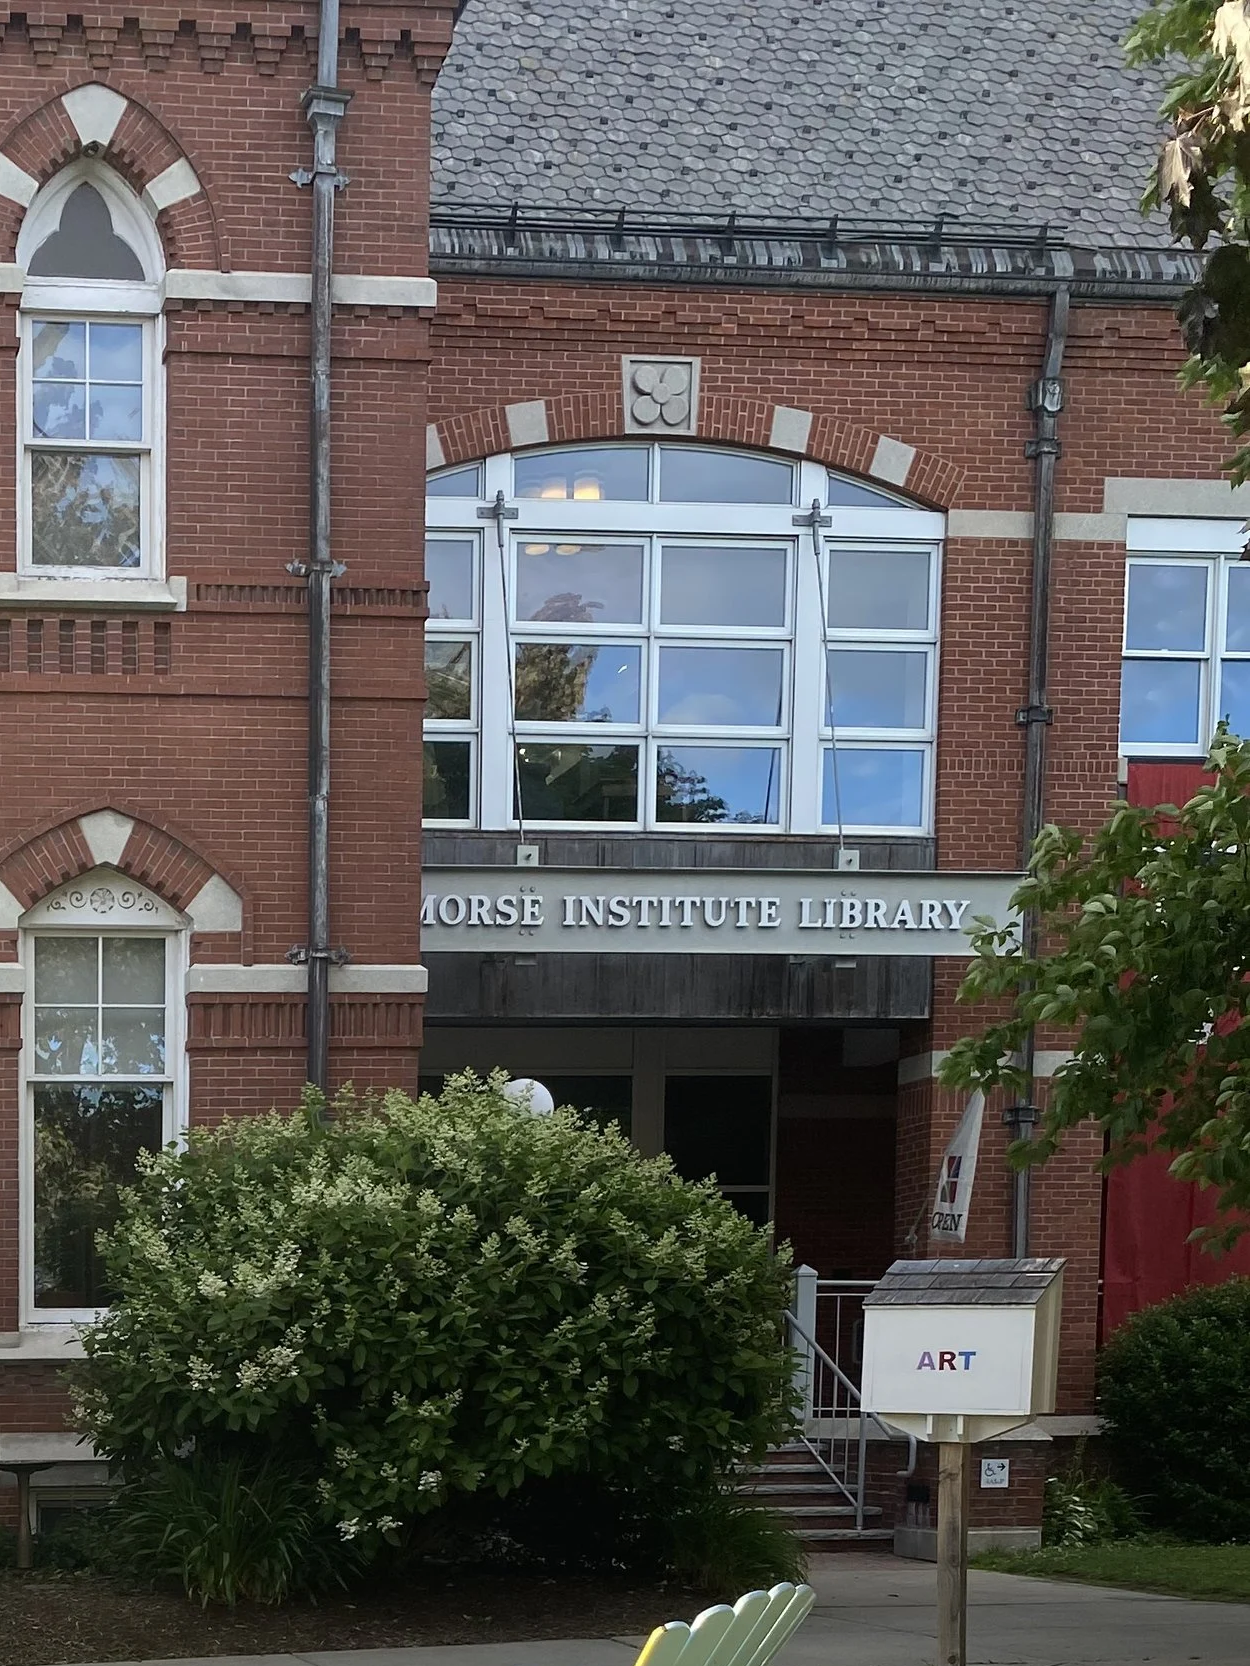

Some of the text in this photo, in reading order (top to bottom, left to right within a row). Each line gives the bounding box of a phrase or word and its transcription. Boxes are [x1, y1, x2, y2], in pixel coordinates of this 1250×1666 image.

[562, 894, 781, 929] INSTITUTE
[798, 897, 971, 931] LIBRARY
[931, 1211, 963, 1232] OPEN
[916, 1350, 977, 1372] ART
